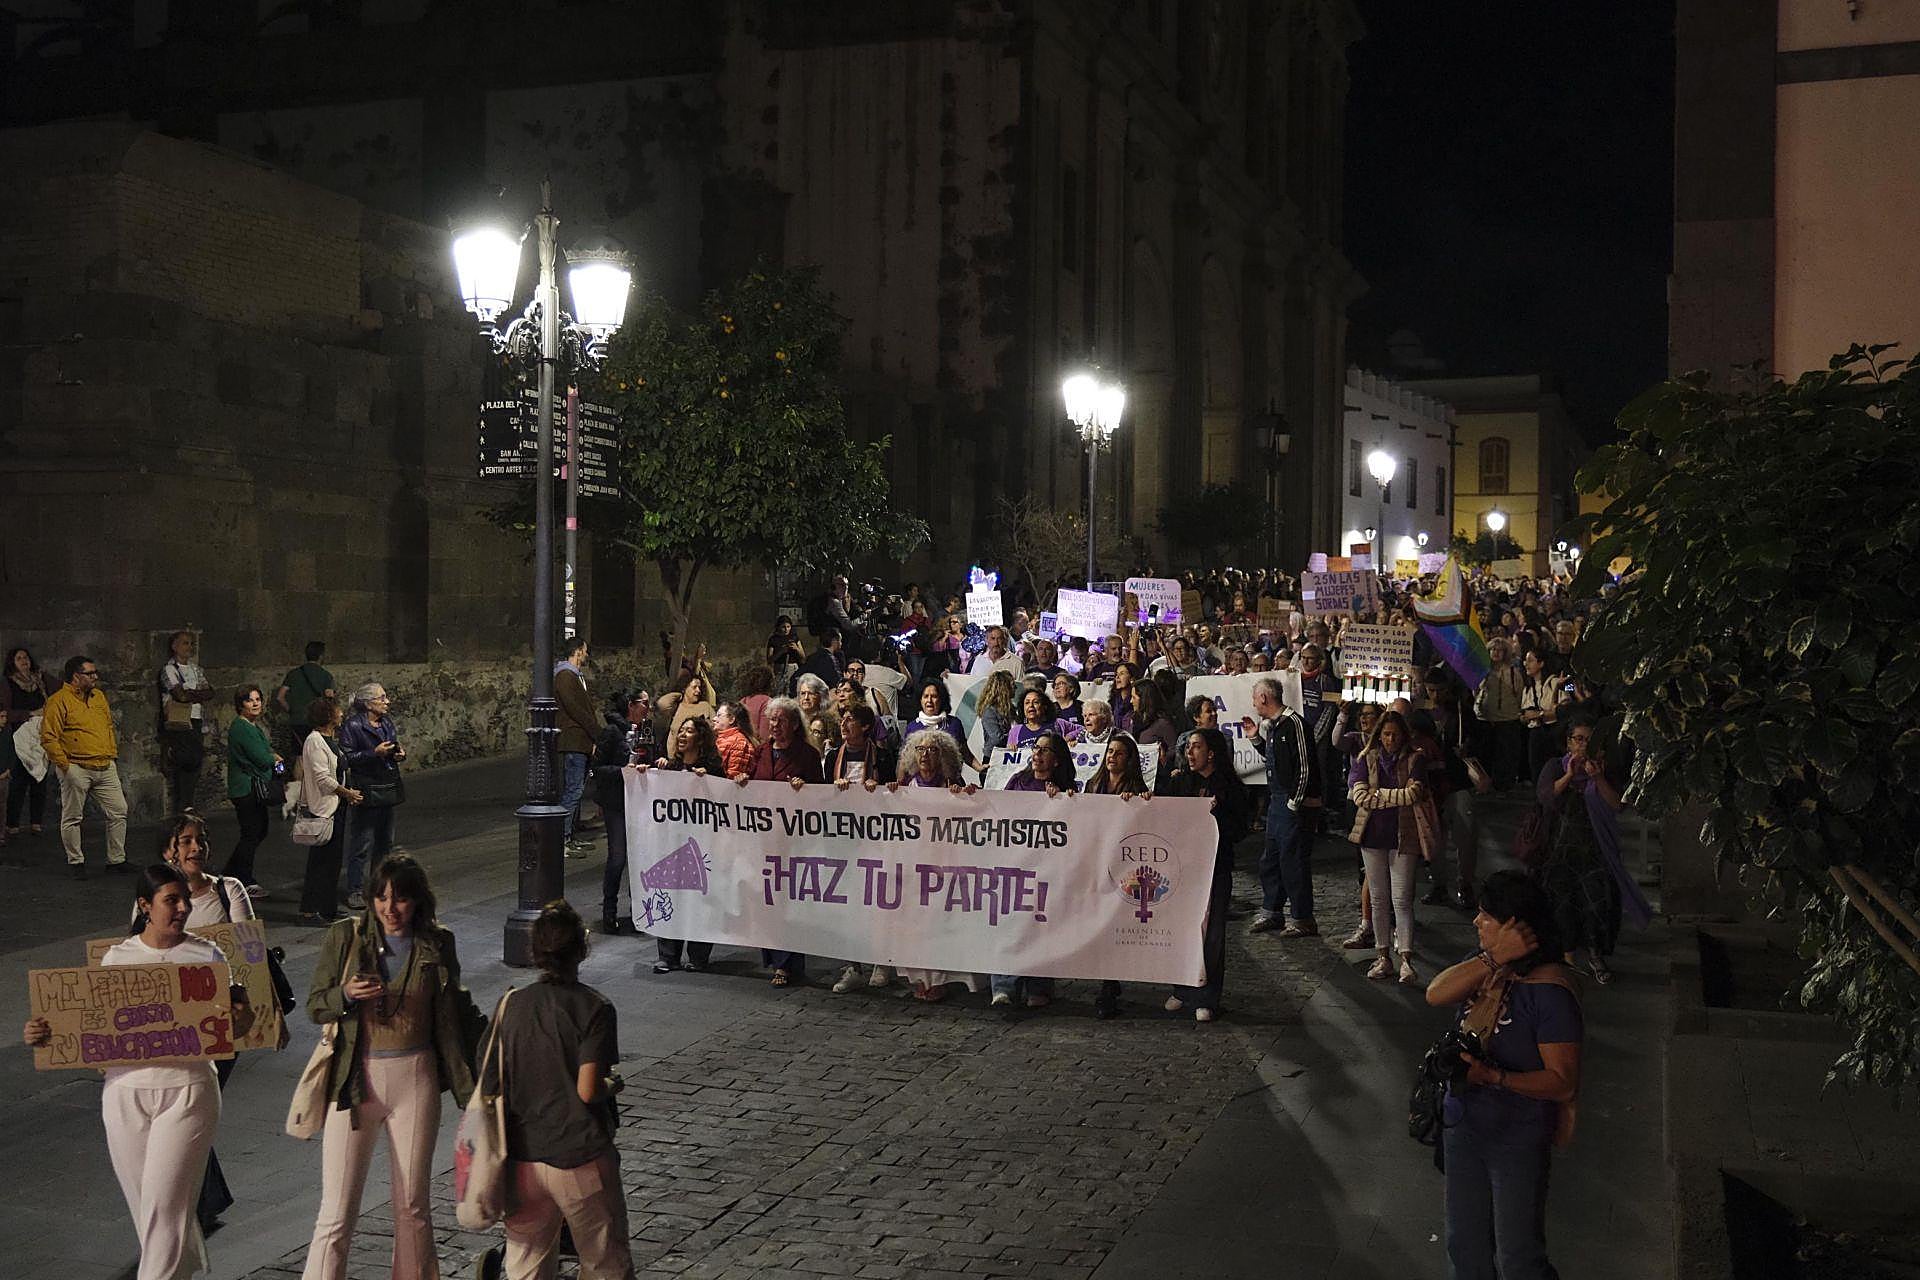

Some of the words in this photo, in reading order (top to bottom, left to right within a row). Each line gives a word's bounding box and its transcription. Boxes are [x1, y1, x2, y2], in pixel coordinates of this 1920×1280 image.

[486, 401, 505, 409] PLAZA
[485, 466, 504, 474] CENTRO
[505, 466, 522, 474] ARTES
[1128, 581, 1166, 591] MUJERES
[1339, 572, 1360, 584] LAS
[1314, 584, 1356, 598] MUJERES
[1315, 597, 1349, 610] SORDAS
[652, 798, 731, 833] CONTRA
[735, 804, 773, 834] LAS
[776, 807, 921, 842] VIOLENCIAS
[927, 816, 1068, 849] MACHISTAS
[1120, 846, 1170, 864] RED
[761, 855, 849, 906] ¡HAZ
[856, 858, 902, 911] TU
[915, 863, 1050, 927] PARTE!
[36, 971, 87, 1014] MI
[178, 965, 218, 1003] NO
[80, 1008, 108, 1032] ES
[50, 1034, 80, 1065] TU
[81, 1021, 202, 1065] EDUCACIÓN
